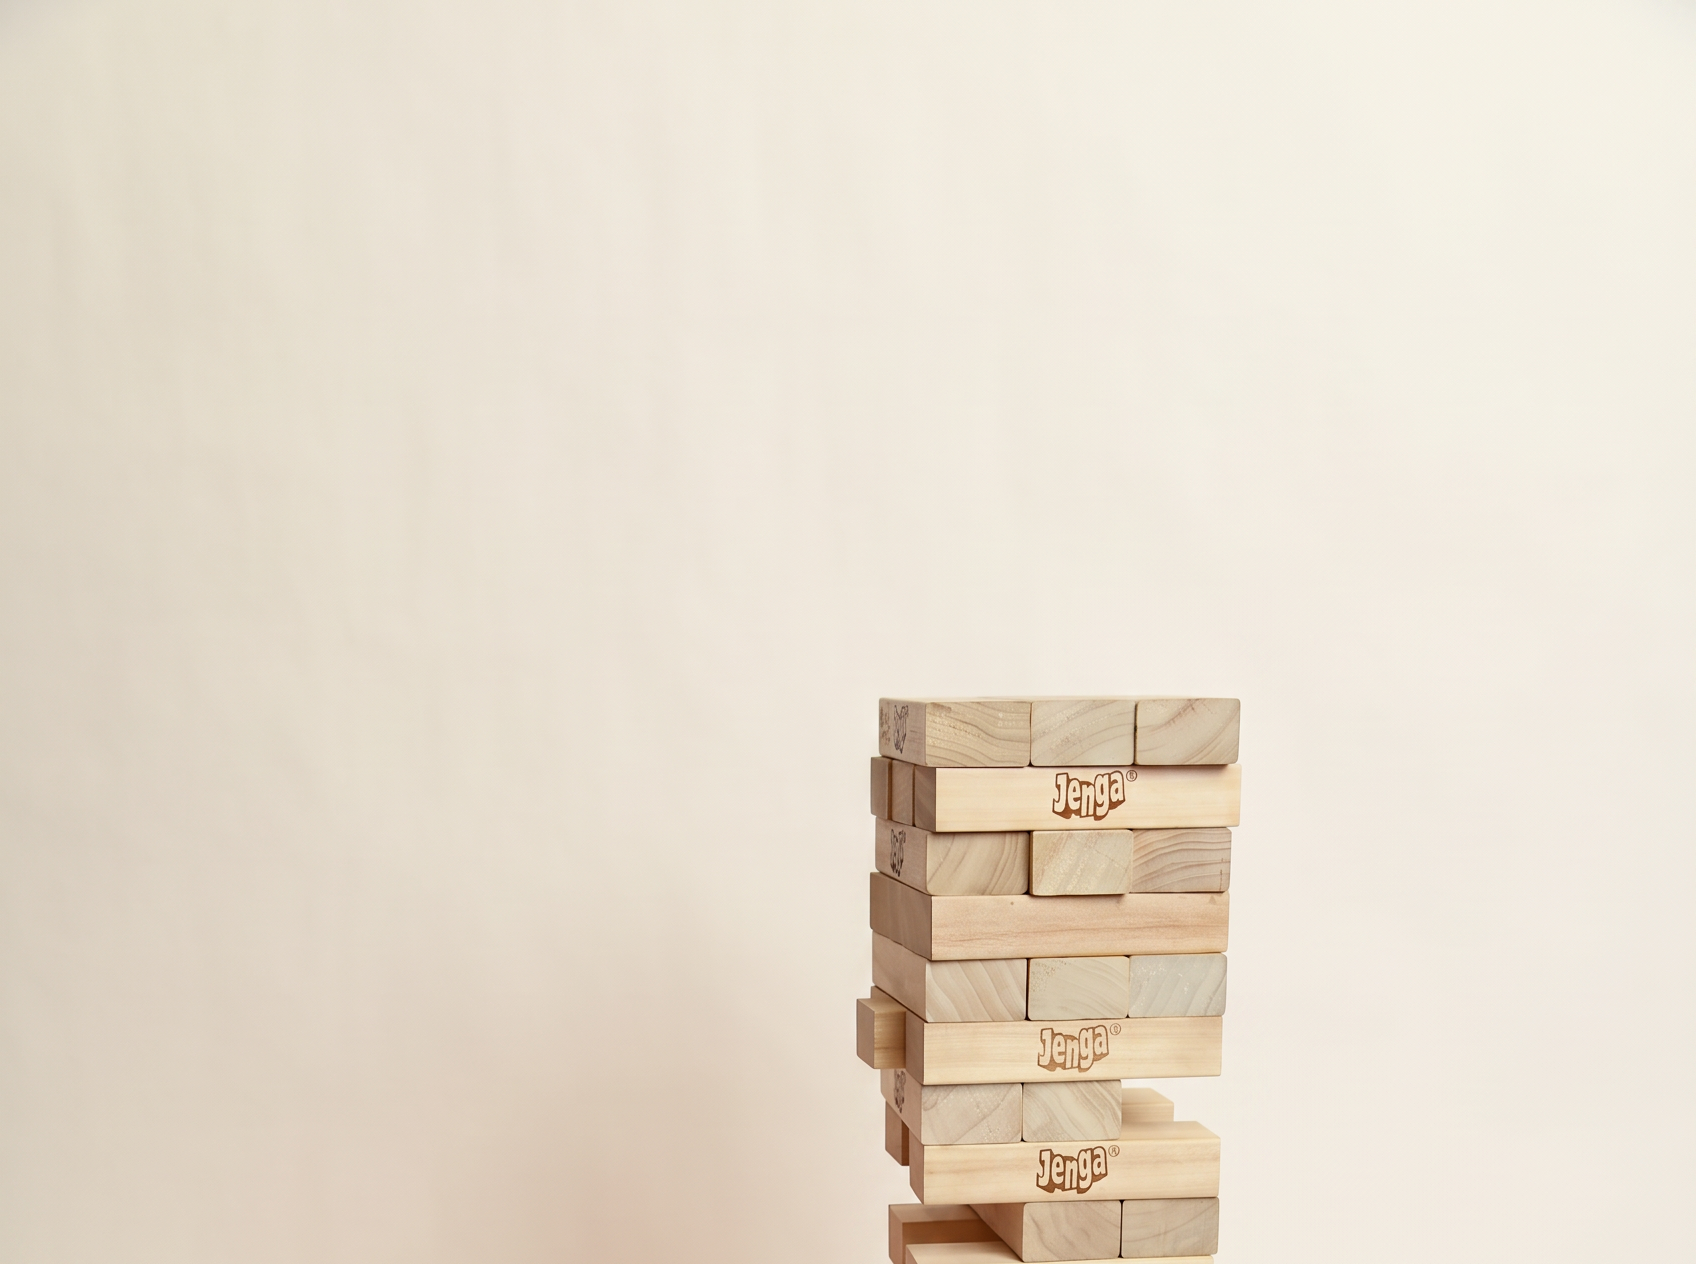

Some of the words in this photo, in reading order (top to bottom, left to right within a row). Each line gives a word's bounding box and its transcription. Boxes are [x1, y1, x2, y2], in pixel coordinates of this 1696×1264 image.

[1052, 770, 1126, 821] Jenga
[1037, 1024, 1109, 1073] Jenga
[1036, 1145, 1109, 1194] Jenga
